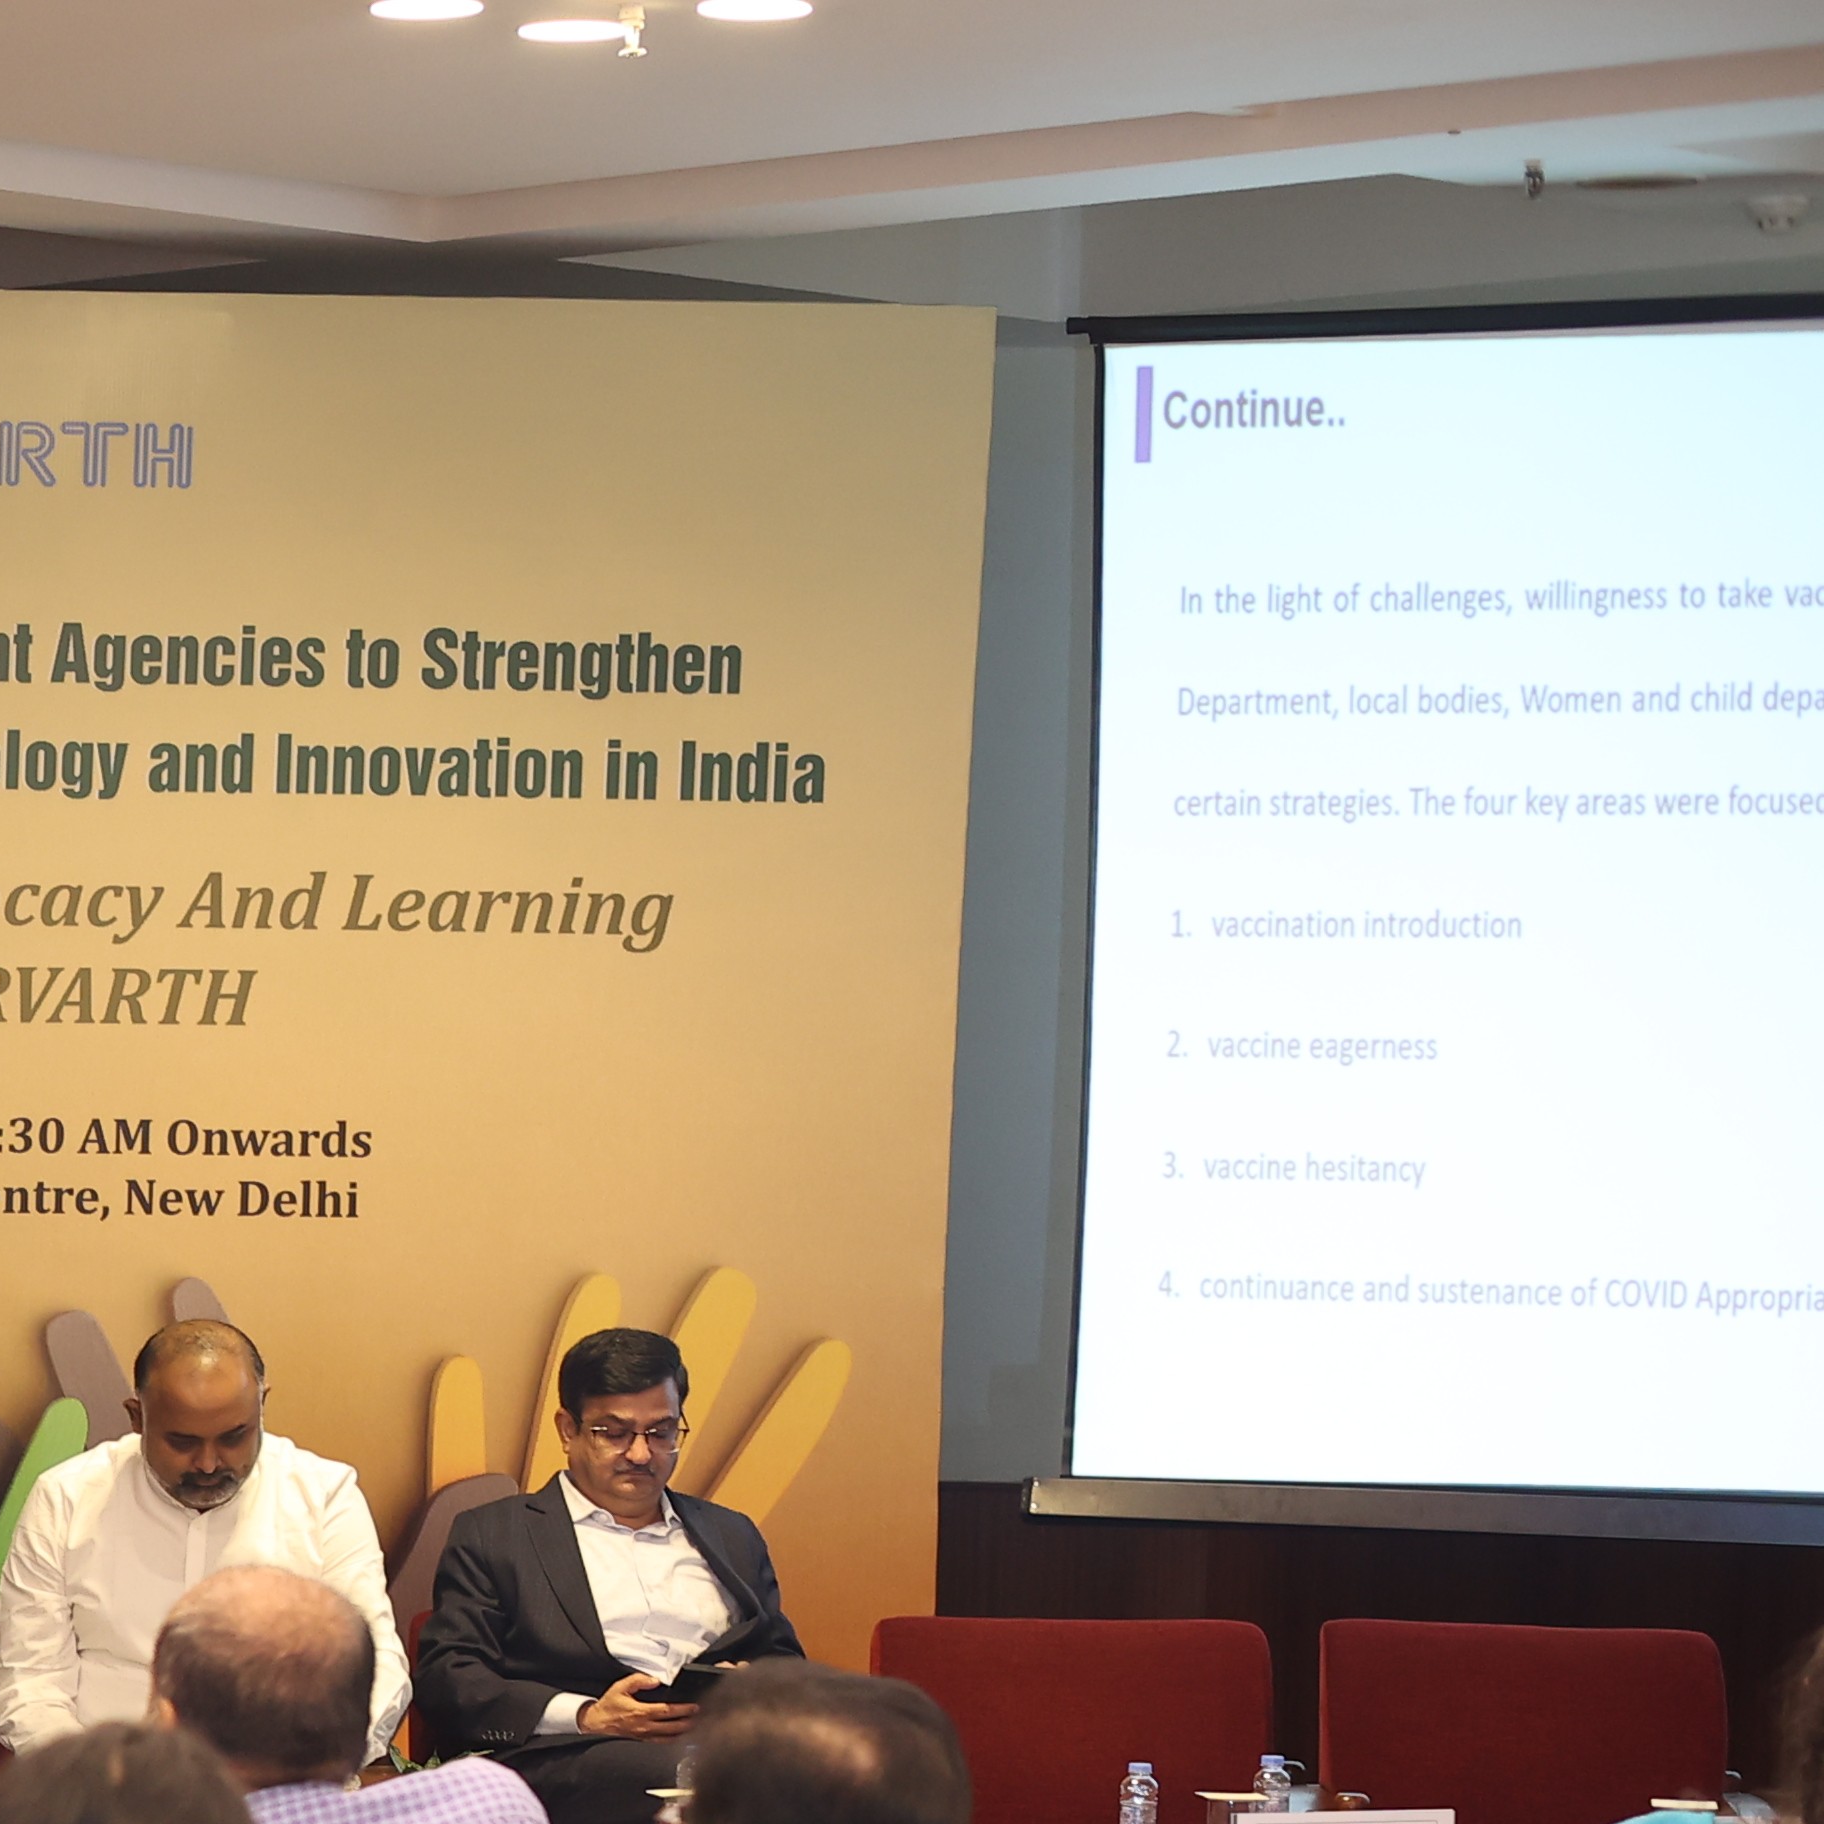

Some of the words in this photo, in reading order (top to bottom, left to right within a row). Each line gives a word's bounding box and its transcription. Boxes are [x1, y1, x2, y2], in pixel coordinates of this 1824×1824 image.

[1164, 389, 1344, 429] Continue..
[1181, 586, 1202, 613] In
[1215, 584, 1256, 614] the
[1268, 584, 1322, 621] light
[1333, 582, 1360, 612] of
[1370, 582, 1512, 619] challenges,
[1525, 580, 1667, 617] willingness
[1680, 584, 1705, 608] to
[1718, 579, 1772, 608] take
[51, 623, 325, 692] Agencies
[346, 629, 399, 688] to
[422, 628, 741, 700] Strengthen
[1178, 687, 1338, 722] Department,
[1350, 684, 1407, 714] local
[1418, 684, 1509, 718] bodies,
[1521, 685, 1621, 713] Women
[1632, 682, 1680, 712] and
[1691, 681, 1752, 712] child
[149, 733, 254, 794] and
[276, 734, 583, 799] Innovation
[606, 739, 657, 800] in
[680, 741, 825, 803] India
[1174, 789, 1261, 816] certain
[1270, 789, 1399, 824] strategies.
[1409, 787, 1455, 816] The
[1464, 786, 1518, 816] four
[1526, 786, 1569, 822] key
[1576, 794, 1646, 815] areas
[1655, 794, 1719, 815] were
[176, 871, 327, 930] And
[341, 875, 674, 953] Learning
[1171, 910, 1191, 938] 1.
[1212, 911, 1354, 938] vaccination
[1365, 909, 1521, 938] introduction
[1167, 1030, 1187, 1058] 2.
[1208, 1032, 1300, 1059] vaccine
[1310, 1038, 1437, 1066] eagerness
[77, 1119, 152, 1154] AM
[168, 1120, 371, 1158] Onwards
[1163, 1151, 1183, 1179] 3.
[1204, 1154, 1296, 1181] vaccine
[1306, 1152, 1426, 1189] hesitancy
[125, 1180, 225, 1216] New
[238, 1180, 358, 1218] Delhi
[1158, 1270, 1179, 1297] 4.
[1200, 1273, 1354, 1302] continuance
[1363, 1274, 1409, 1302] and
[1419, 1280, 1562, 1306] sustenance
[1571, 1277, 1598, 1306] of
[1605, 1279, 1687, 1309] COVID
